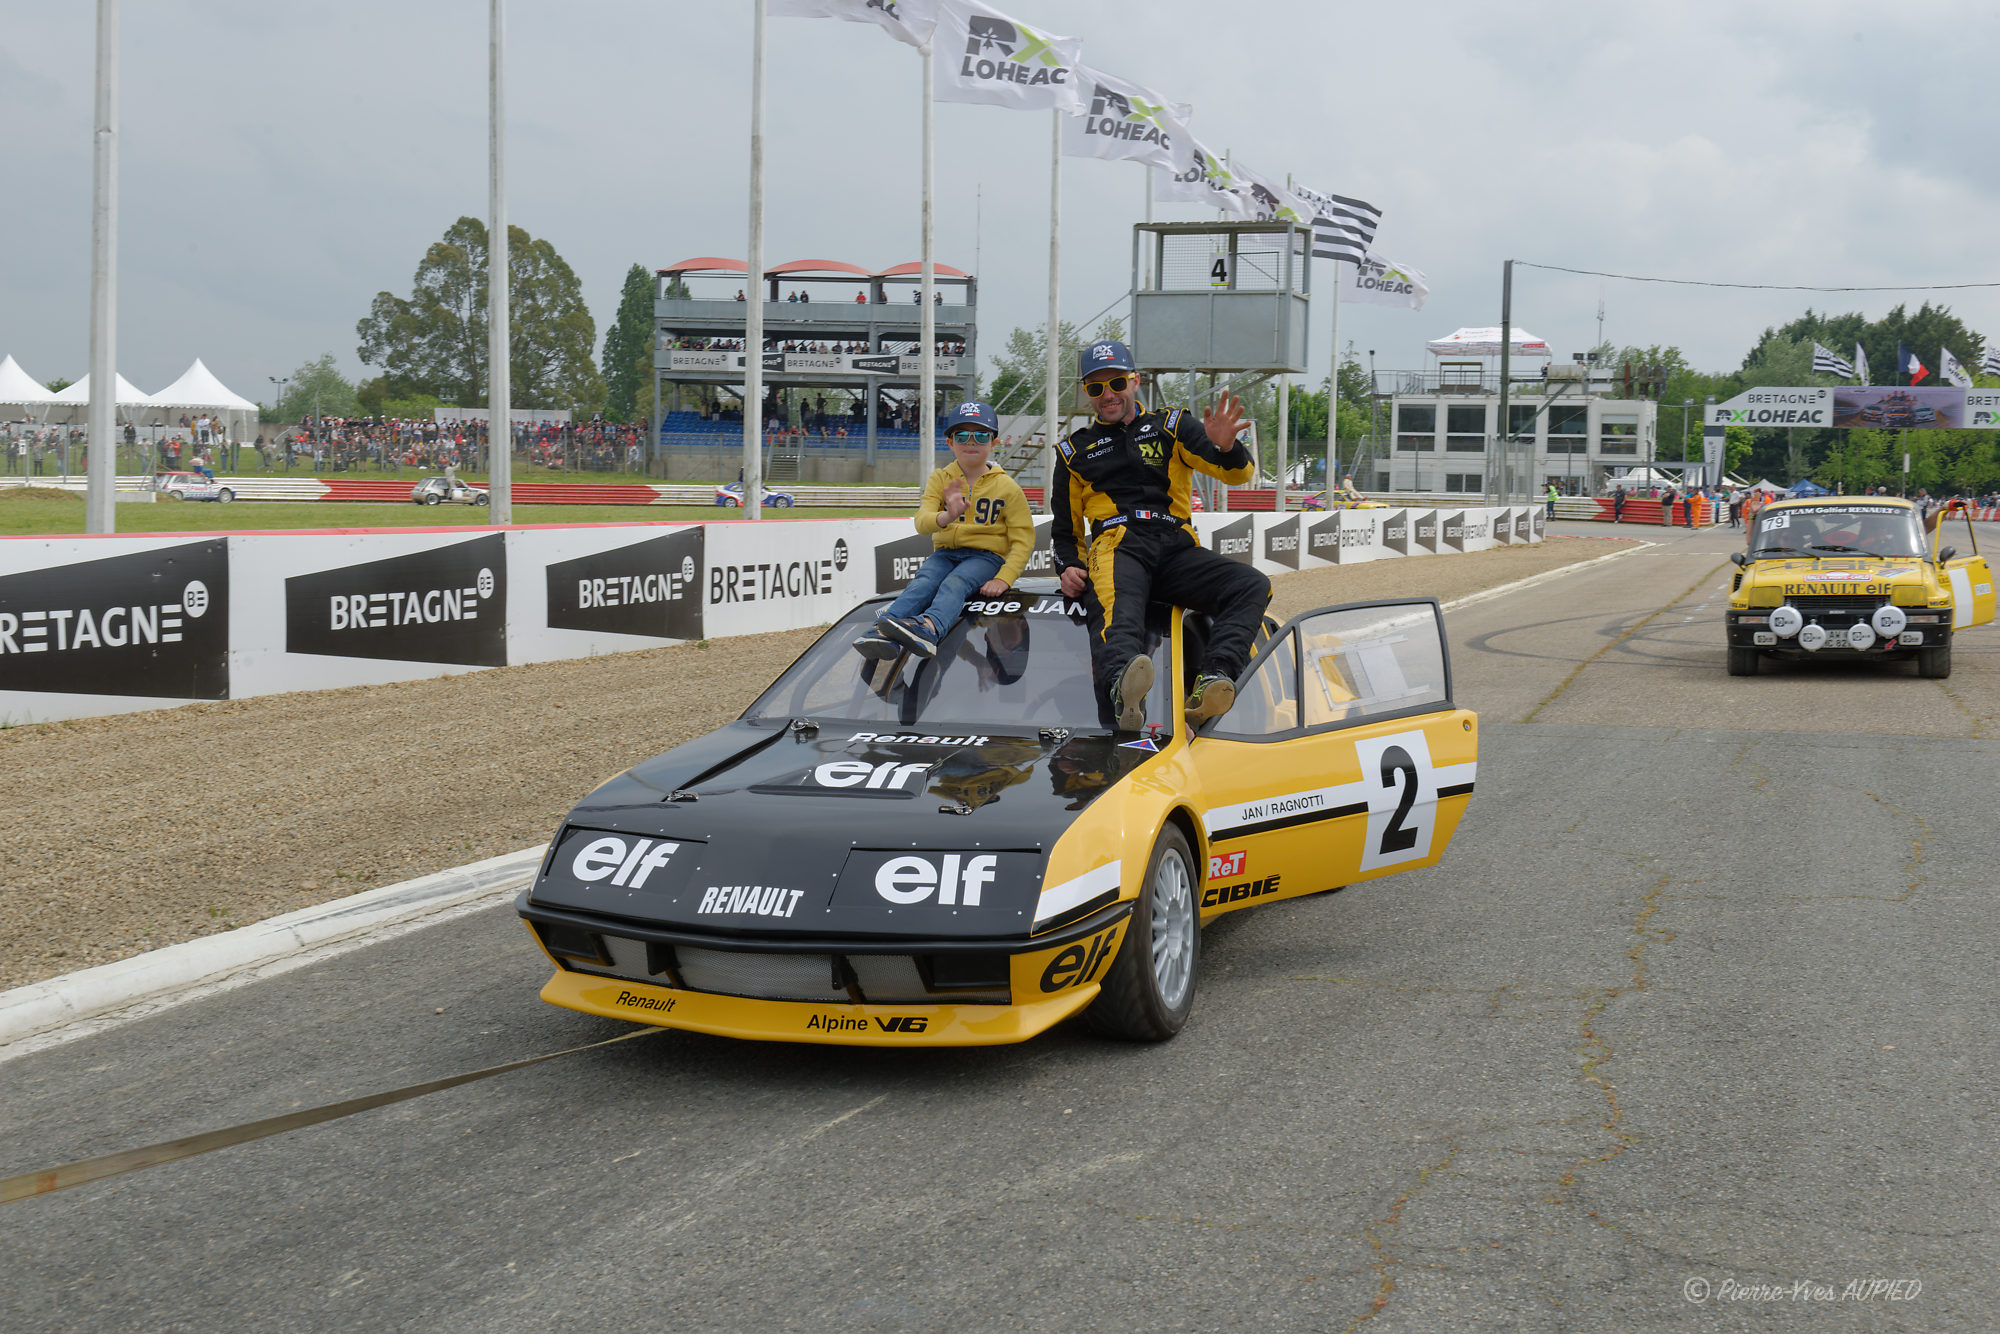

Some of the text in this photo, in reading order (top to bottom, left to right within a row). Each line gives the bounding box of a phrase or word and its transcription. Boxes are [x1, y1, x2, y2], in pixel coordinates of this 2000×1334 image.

[960, 56, 1069, 85] LOHEAC
[1085, 117, 1170, 150] LOHEAC
[1211, 258, 1227, 282] 4
[1356, 277, 1413, 294] LOHEAC
[673, 357, 720, 366] BRETAGNE
[787, 359, 834, 368] BRETAGNE
[1748, 394, 1816, 404] BRETAGNE
[1967, 396, 2000, 406] BRET
[1747, 410, 1824, 424] LOHEAC
[975, 498, 1005, 525] 96
[1767, 517, 1784, 529] 79
[1784, 507, 1813, 515] TEAM
[578, 572, 683, 609] BRETAGNE
[710, 560, 832, 605] BRETAGNE
[1784, 584, 1860, 595] RENAULT
[330, 587, 477, 630] BRETAGNE
[961, 600, 1022, 616] rage
[0, 604, 182, 655] RETAGNE
[846, 732, 990, 747] Renault
[814, 761, 934, 789] elf
[1242, 805, 1263, 821] JAN
[1272, 794, 1324, 815] RAGNOTTI
[1380, 745, 1418, 854] 2
[572, 836, 680, 889] elf
[1208, 852, 1245, 878] ReT
[874, 854, 997, 906] elf
[698, 885, 804, 918] RENAULT
[1039, 927, 1118, 993] elf
[616, 990, 676, 1012] Renault
[807, 1014, 928, 1033] Alpine V6
